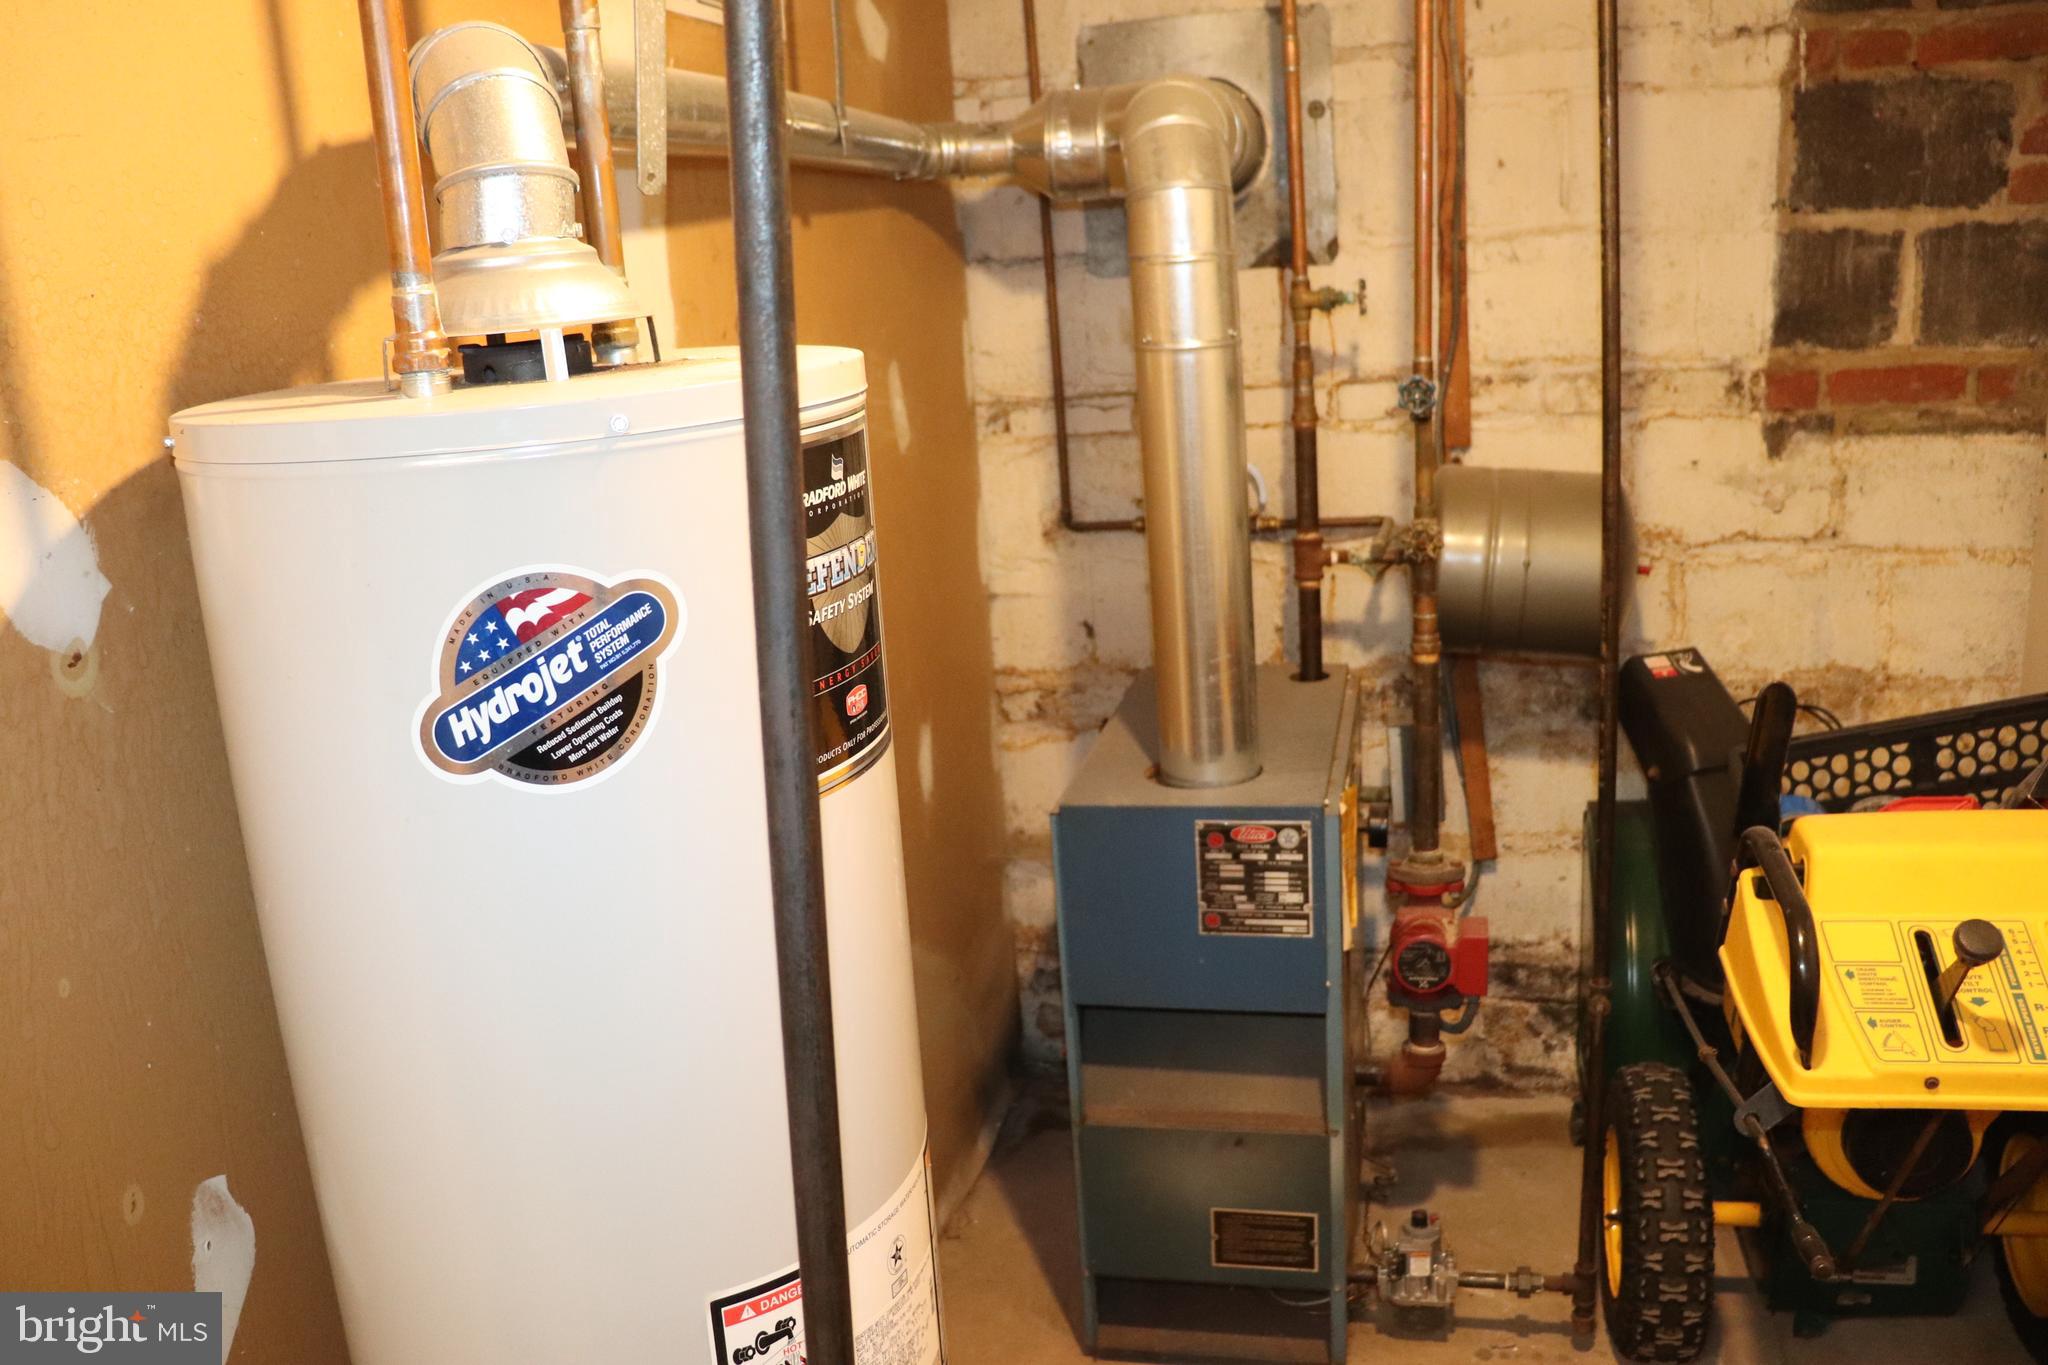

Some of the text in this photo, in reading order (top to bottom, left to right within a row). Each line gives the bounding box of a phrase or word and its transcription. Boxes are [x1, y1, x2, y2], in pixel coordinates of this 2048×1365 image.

[802, 469, 866, 508] RADFORD WHITE
[808, 489, 865, 517] ORPORATION
[847, 579, 874, 609] SYSTEM
[449, 611, 472, 645] MADE
[480, 592, 494, 604] IN
[583, 618, 613, 642] TOTAL
[589, 602, 653, 652] PERFORMANCE
[473, 612, 585, 686] EQUIPPED WITH
[594, 632, 630, 664] SYSTEM
[448, 639, 589, 748] Hydrojet
[814, 665, 856, 692] NERGY
[498, 663, 656, 782] BRADFORD WHITE CORPORATION
[531, 682, 609, 736] FEATURING
[536, 693, 624, 754] Reduced Sediment Buildup
[550, 709, 624, 760] Lower Operating Costs
[568, 725, 620, 763] More Hot Water
[842, 735, 857, 751] ONLY
[857, 727, 866, 743] FOR
[847, 1227, 878, 1256] UTOMATIC
[760, 1286, 803, 1311] DANGE
[783, 1341, 803, 1357] HOT
